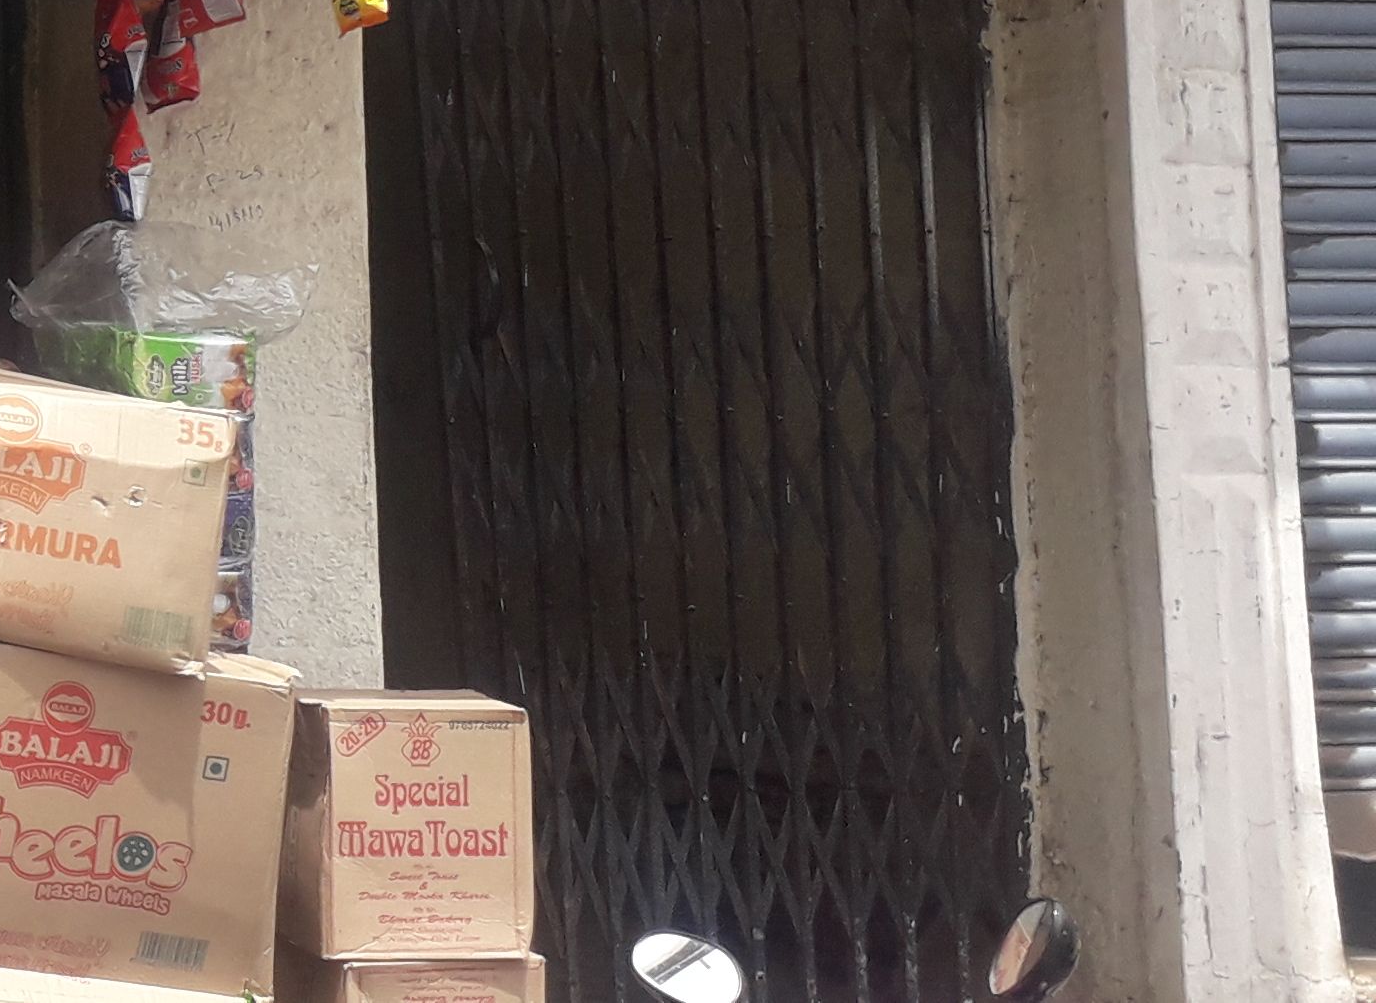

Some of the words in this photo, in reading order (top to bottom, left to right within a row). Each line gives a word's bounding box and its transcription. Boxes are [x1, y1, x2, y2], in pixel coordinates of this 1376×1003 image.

[171, 357, 189, 395] Milk
[410, 739, 433, 761] BB
[18, 766, 98, 792] NAMKEEN
[374, 774, 470, 815] Special
[337, 820, 424, 858] Mawa
[425, 820, 509, 858] Toast
[35, 881, 102, 903] Masala
[105, 885, 172, 917] Wheels
